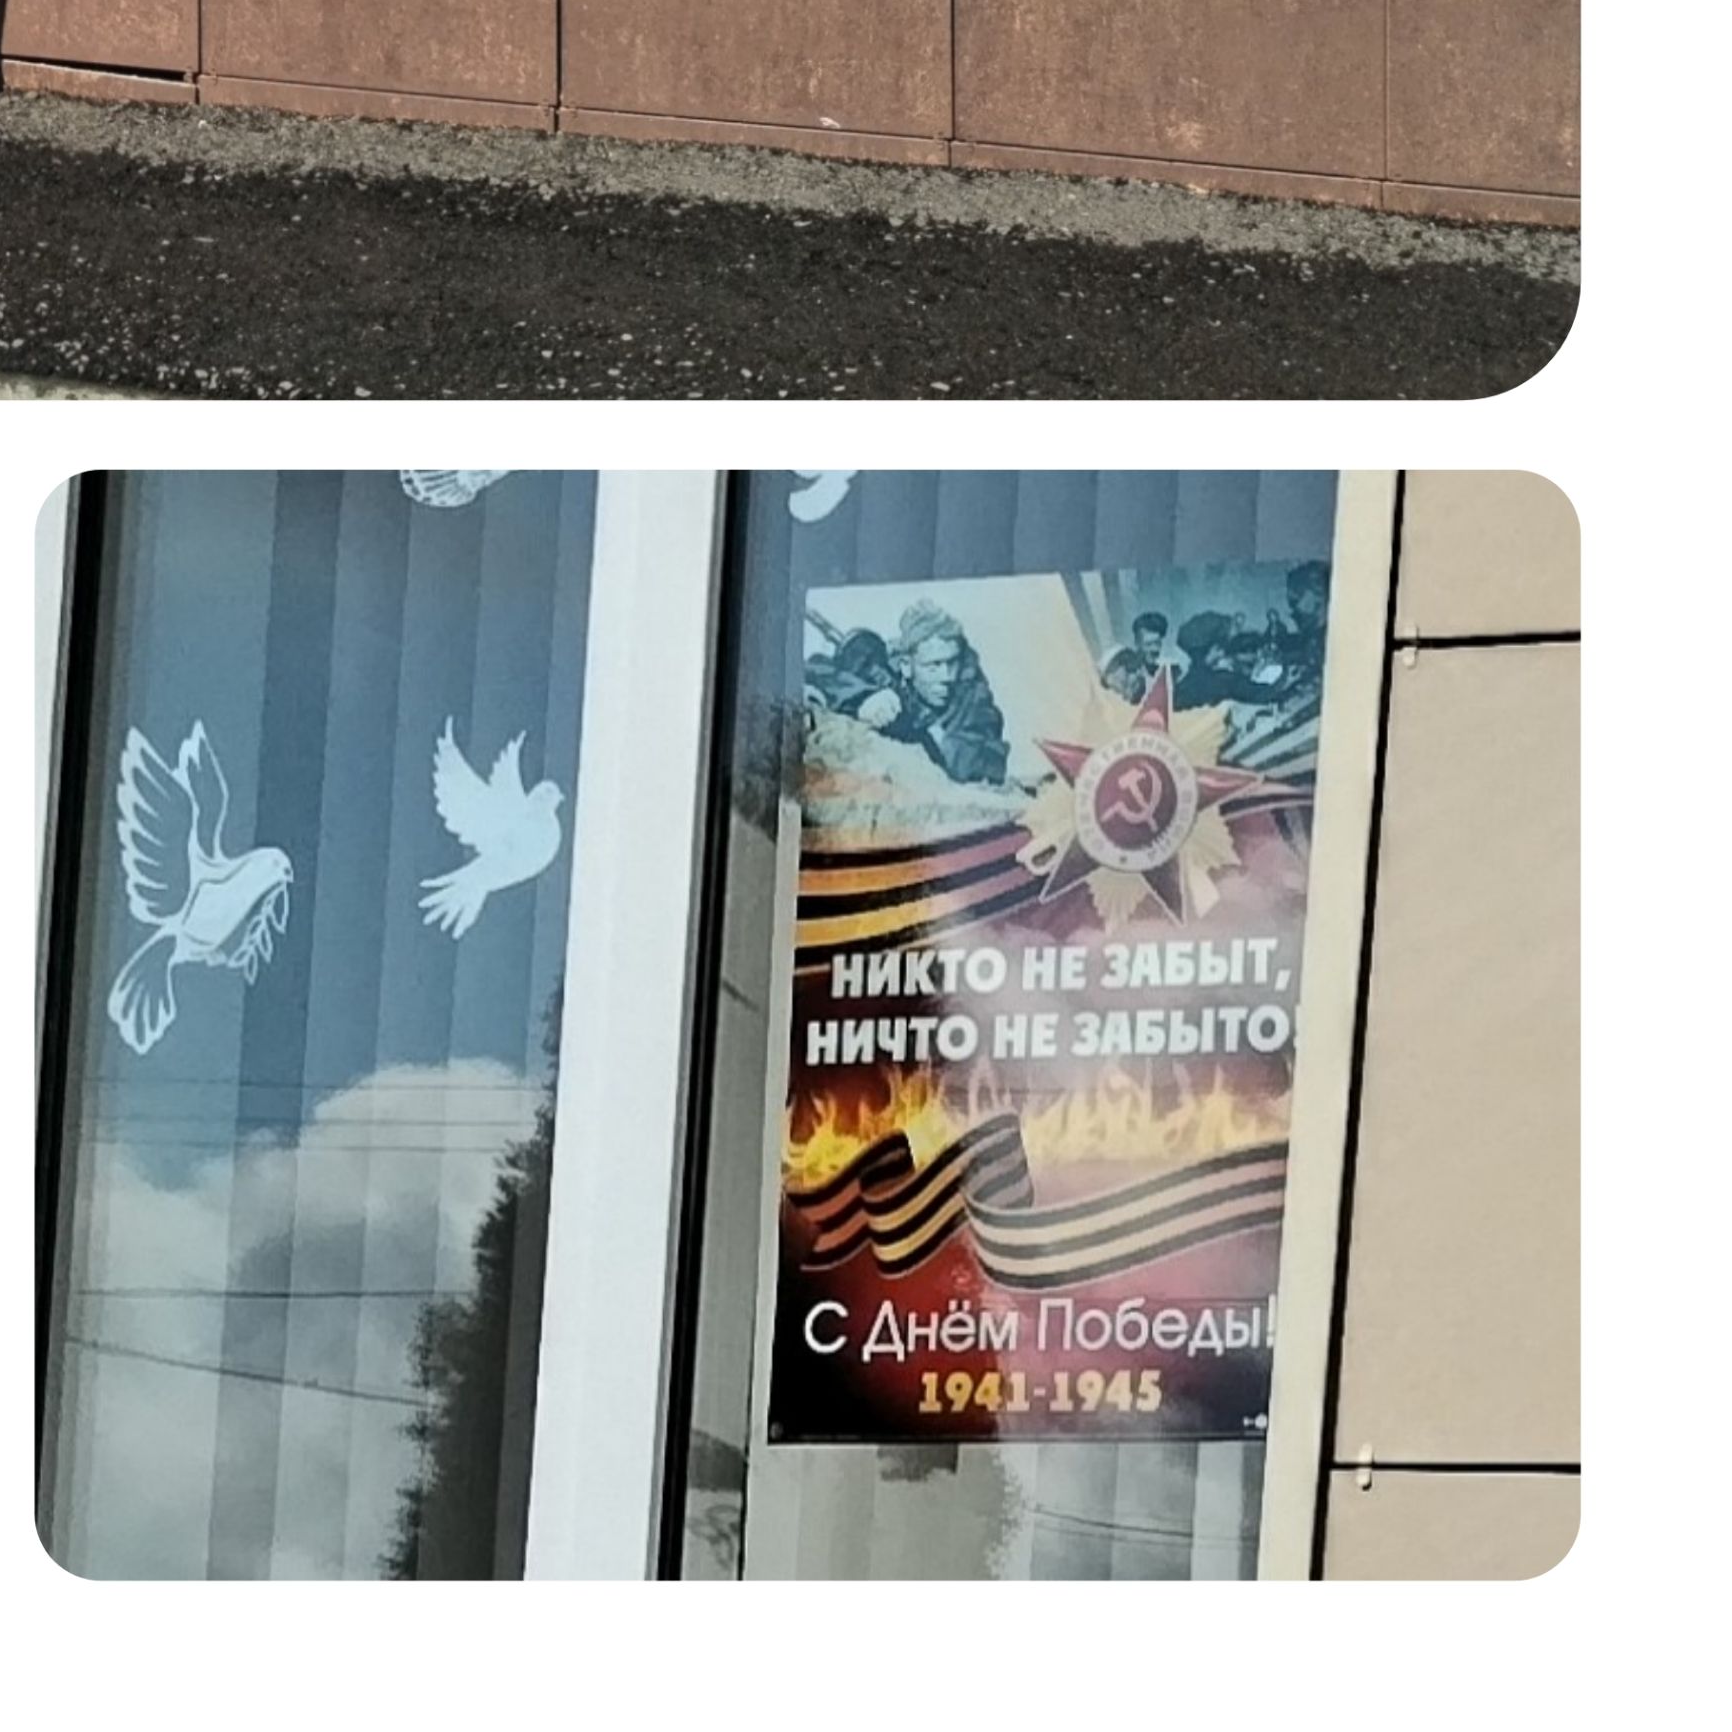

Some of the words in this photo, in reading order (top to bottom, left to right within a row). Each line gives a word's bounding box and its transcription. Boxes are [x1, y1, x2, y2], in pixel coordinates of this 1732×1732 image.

[831, 948, 1007, 998] НИКТО
[1022, 947, 1087, 991] НЕ
[1100, 938, 1291, 992] ЗАБЫТ,
[805, 1014, 978, 1066] НИЧТО
[993, 1014, 1058, 1059] НЕ
[804, 1300, 848, 1354] С
[862, 1293, 1018, 1362] Днём
[1037, 1296, 1277, 1357] Победы!
[918, 1369, 1163, 1414] 1941-1945
